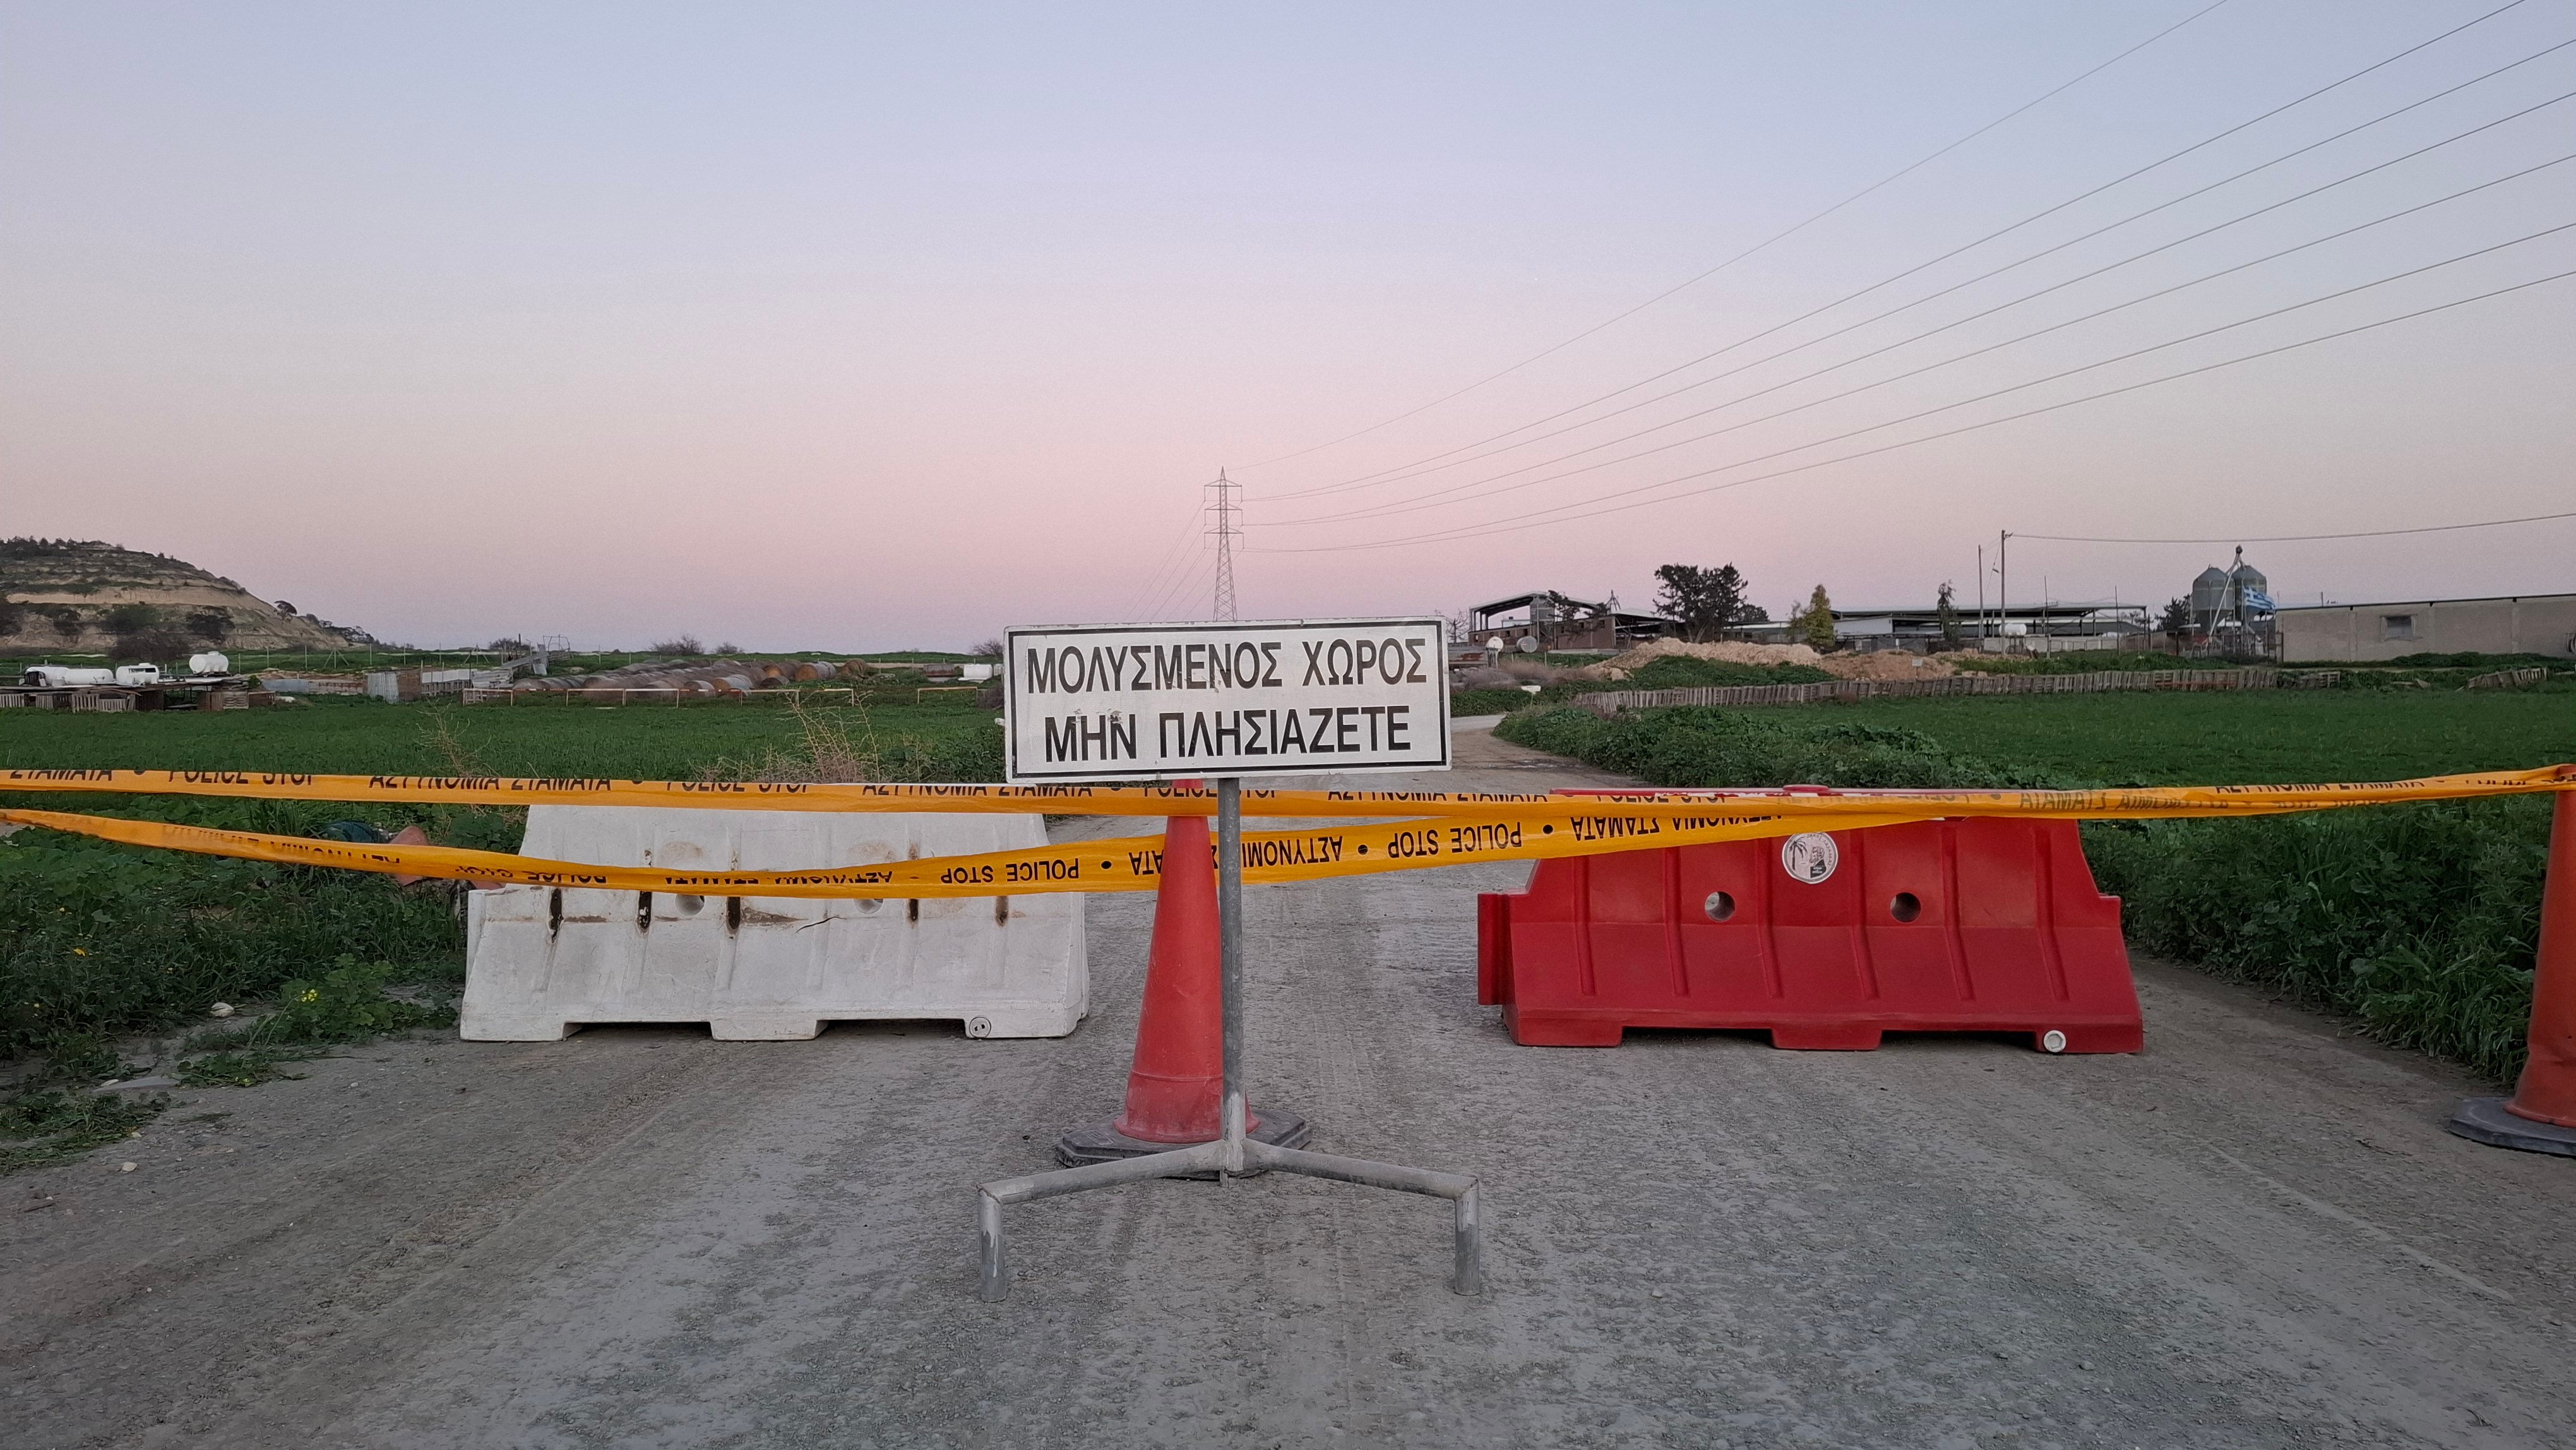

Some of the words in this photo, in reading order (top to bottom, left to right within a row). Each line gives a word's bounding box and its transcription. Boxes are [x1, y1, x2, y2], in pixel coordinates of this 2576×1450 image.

[1027, 642, 1282, 693] ΜΟΛΥΣΜΕΝΟΣ
[1301, 638, 1428, 686] ΧΩΡΟΣ
[1045, 713, 1137, 762] ΜΗΝ
[1159, 705, 1411, 758] ΠΛΗΣΙΑΖΕΤΕ
[1387, 828, 1439, 858] STOP
[1451, 822, 1522, 854] POLICE
[1570, 816, 1661, 841] ΣΤΑΜΑΤΑ
[1241, 836, 1343, 868] ΑΣΤΥΝΟΜΙ
[940, 865, 994, 884] STOP
[1006, 857, 1080, 882] POLICE
